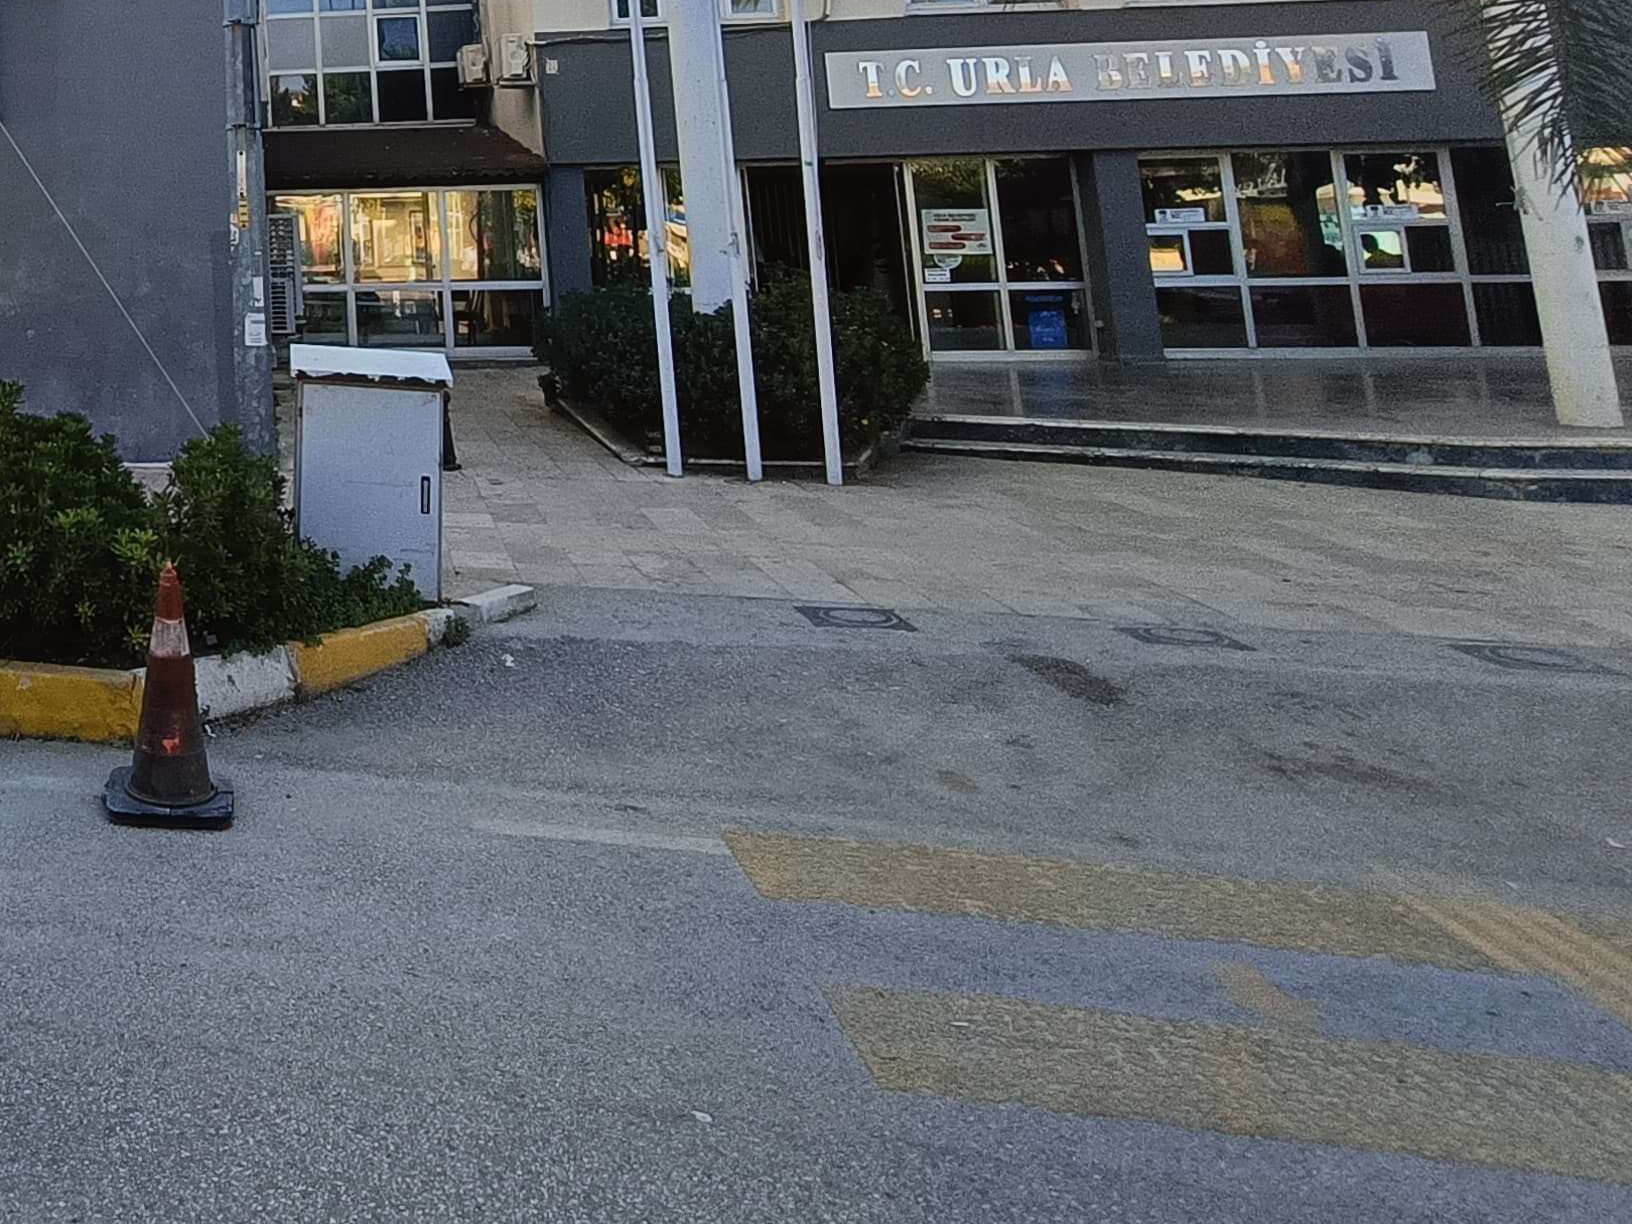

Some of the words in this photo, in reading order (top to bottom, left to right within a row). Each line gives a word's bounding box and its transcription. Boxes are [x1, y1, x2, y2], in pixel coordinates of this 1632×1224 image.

[858, 59, 933, 98] T.C.
[946, 55, 1073, 97] URLA
[1092, 38, 1400, 91] BELEDİYESİ
